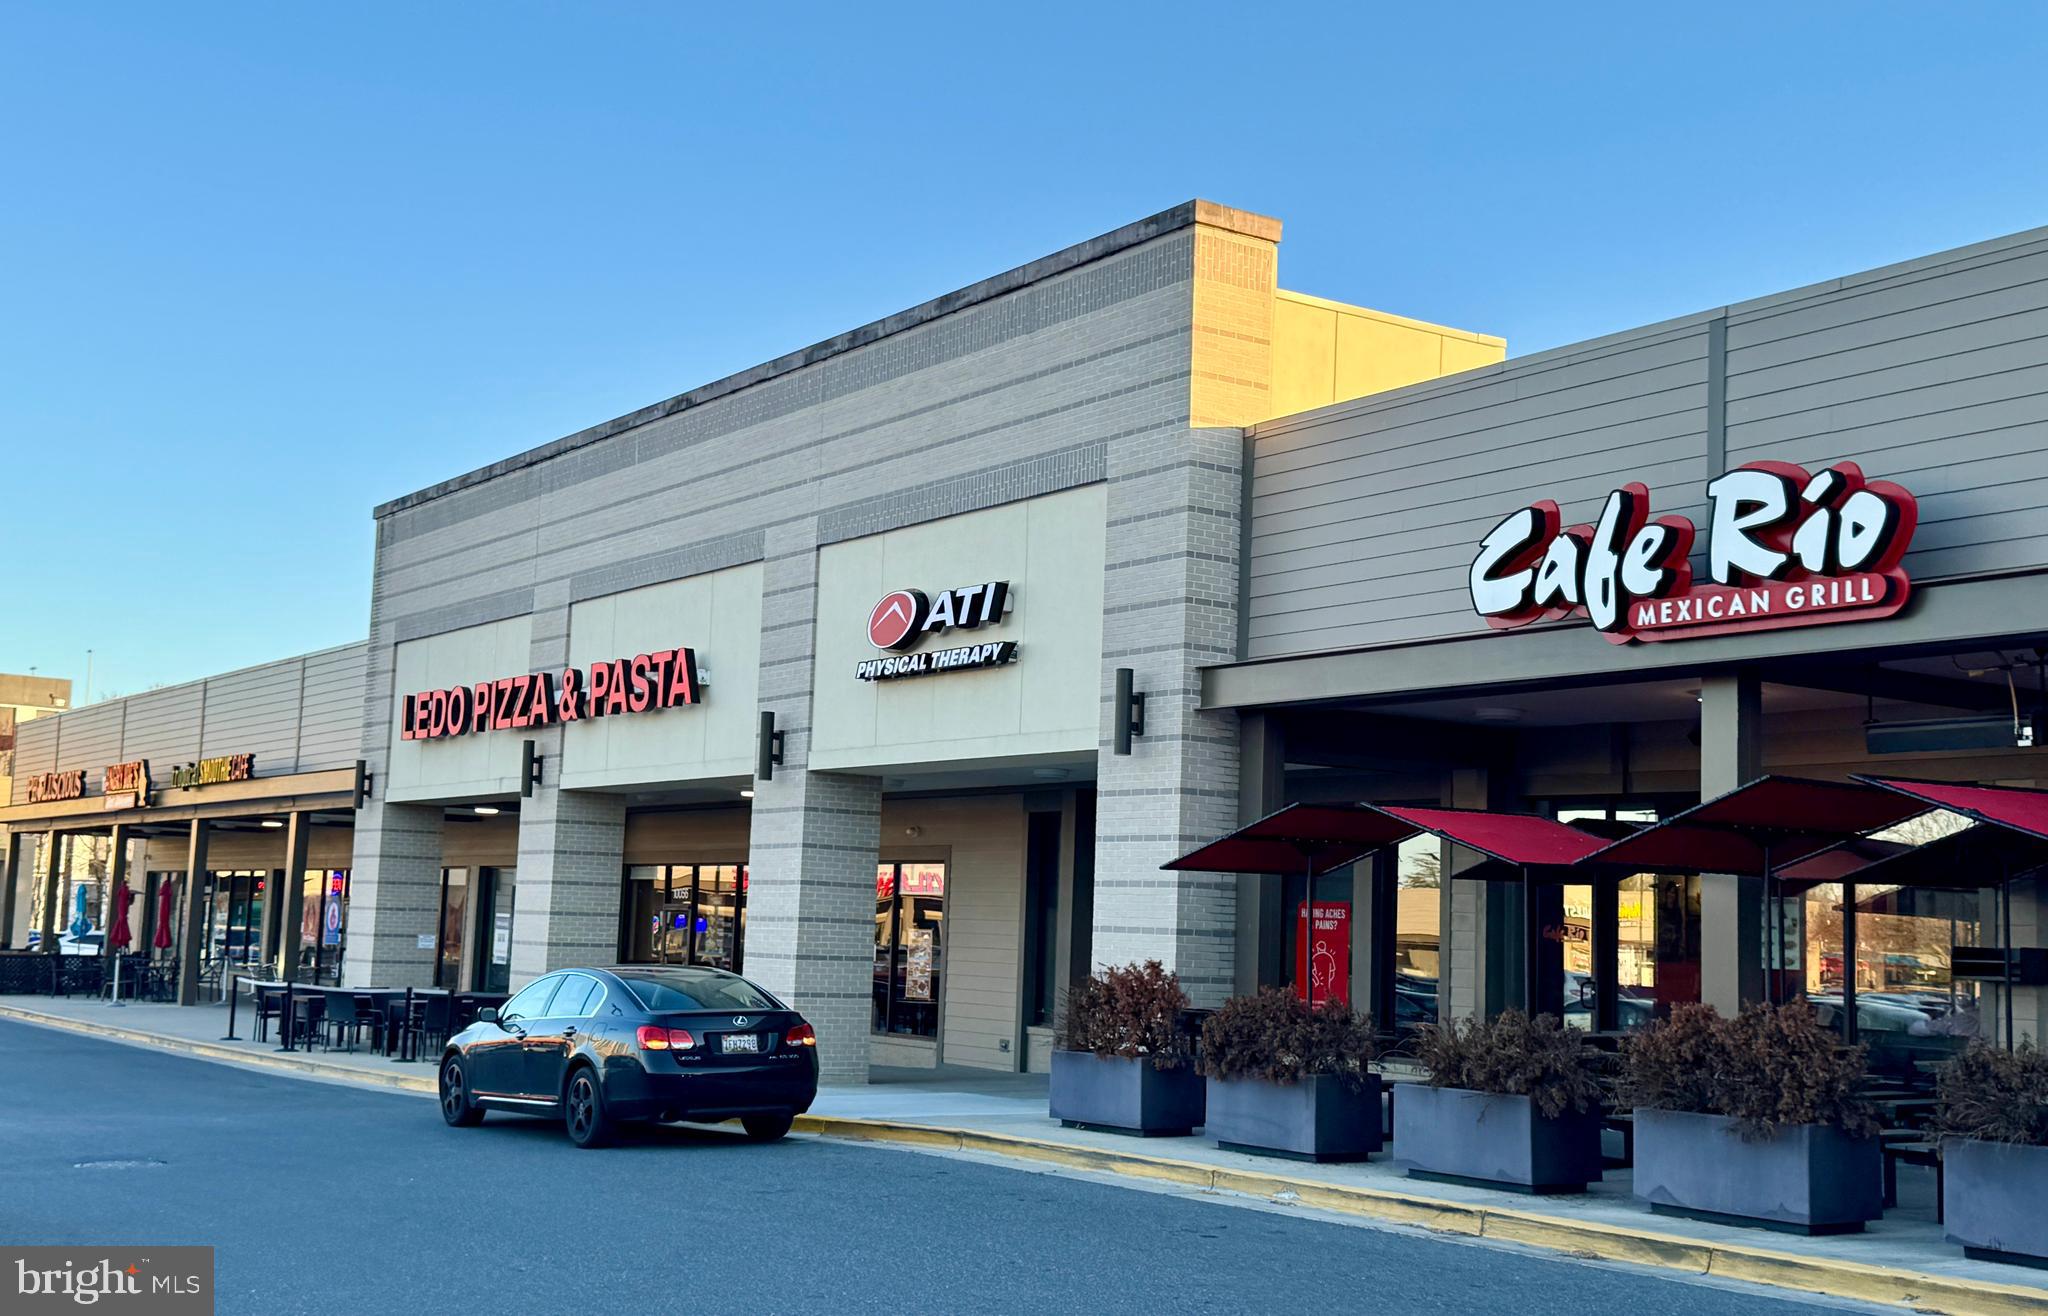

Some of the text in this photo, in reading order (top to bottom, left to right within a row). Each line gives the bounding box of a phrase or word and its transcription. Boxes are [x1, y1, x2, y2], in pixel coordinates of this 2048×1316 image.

[1469, 489, 1674, 632] Cafe
[920, 581, 997, 632] ATI
[1636, 578, 1875, 627] MEXICAN GRILL
[856, 642, 1004, 678] PHYSICAL THERAPY
[401, 647, 695, 741] LEDO PIZZA & PASTA
[1315, 919, 1338, 930] PAINS?
[1325, 908, 1346, 919] ACHES
